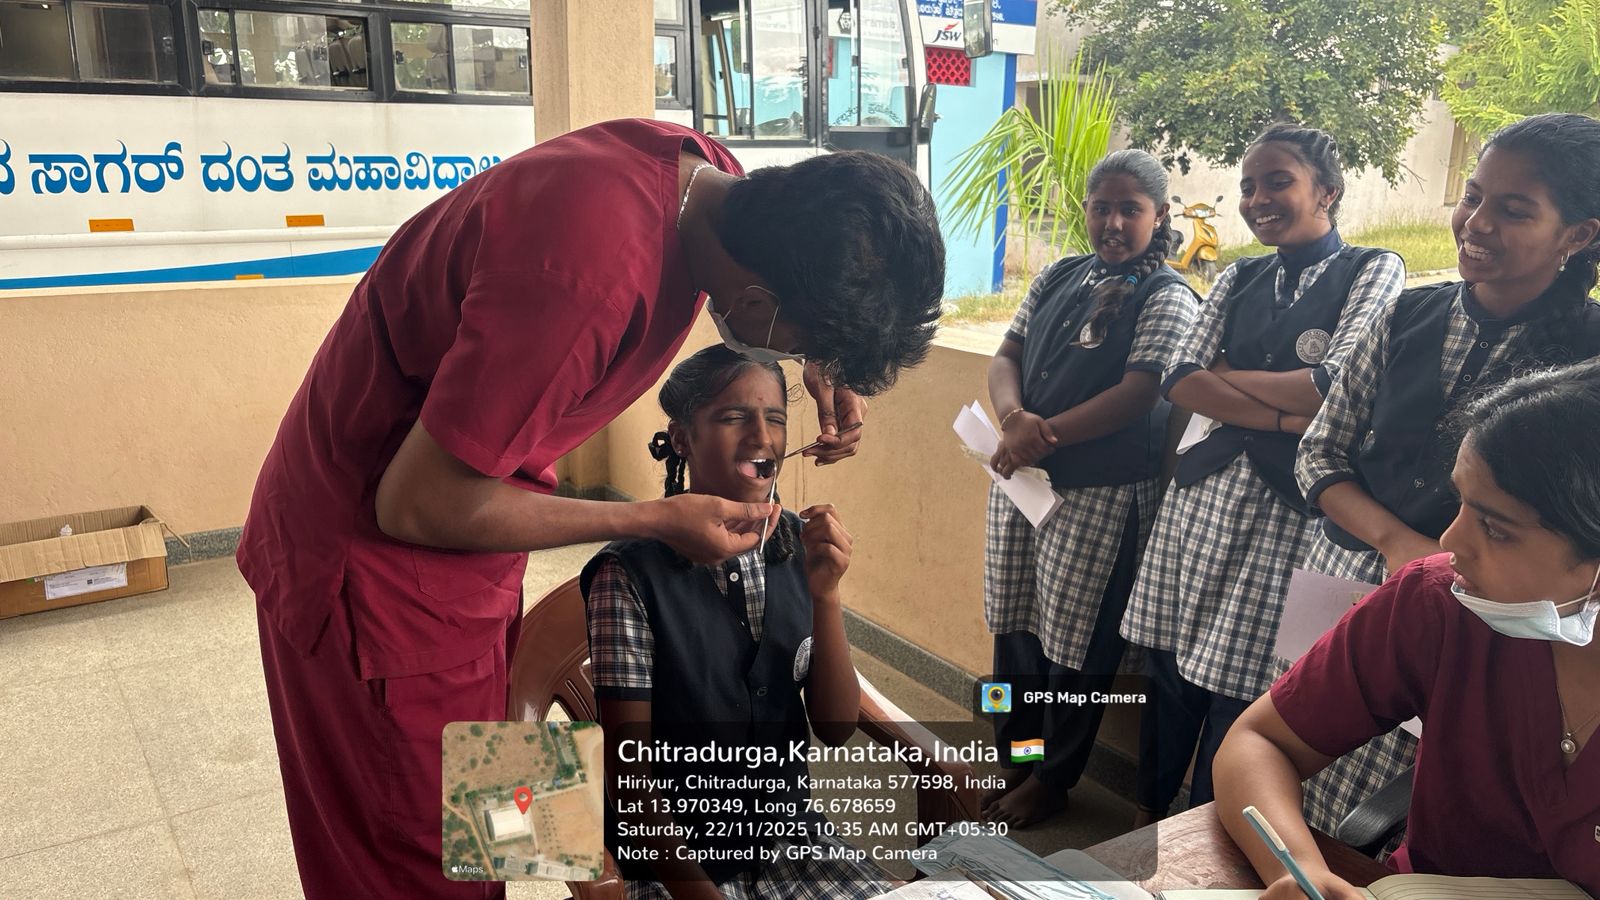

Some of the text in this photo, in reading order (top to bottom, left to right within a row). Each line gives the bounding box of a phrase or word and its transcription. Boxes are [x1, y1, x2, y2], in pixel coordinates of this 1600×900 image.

[931, 30, 961, 43] JSW
[28, 139, 185, 195] ಸಾಗರ್
[200, 141, 294, 193] ದಂತ
